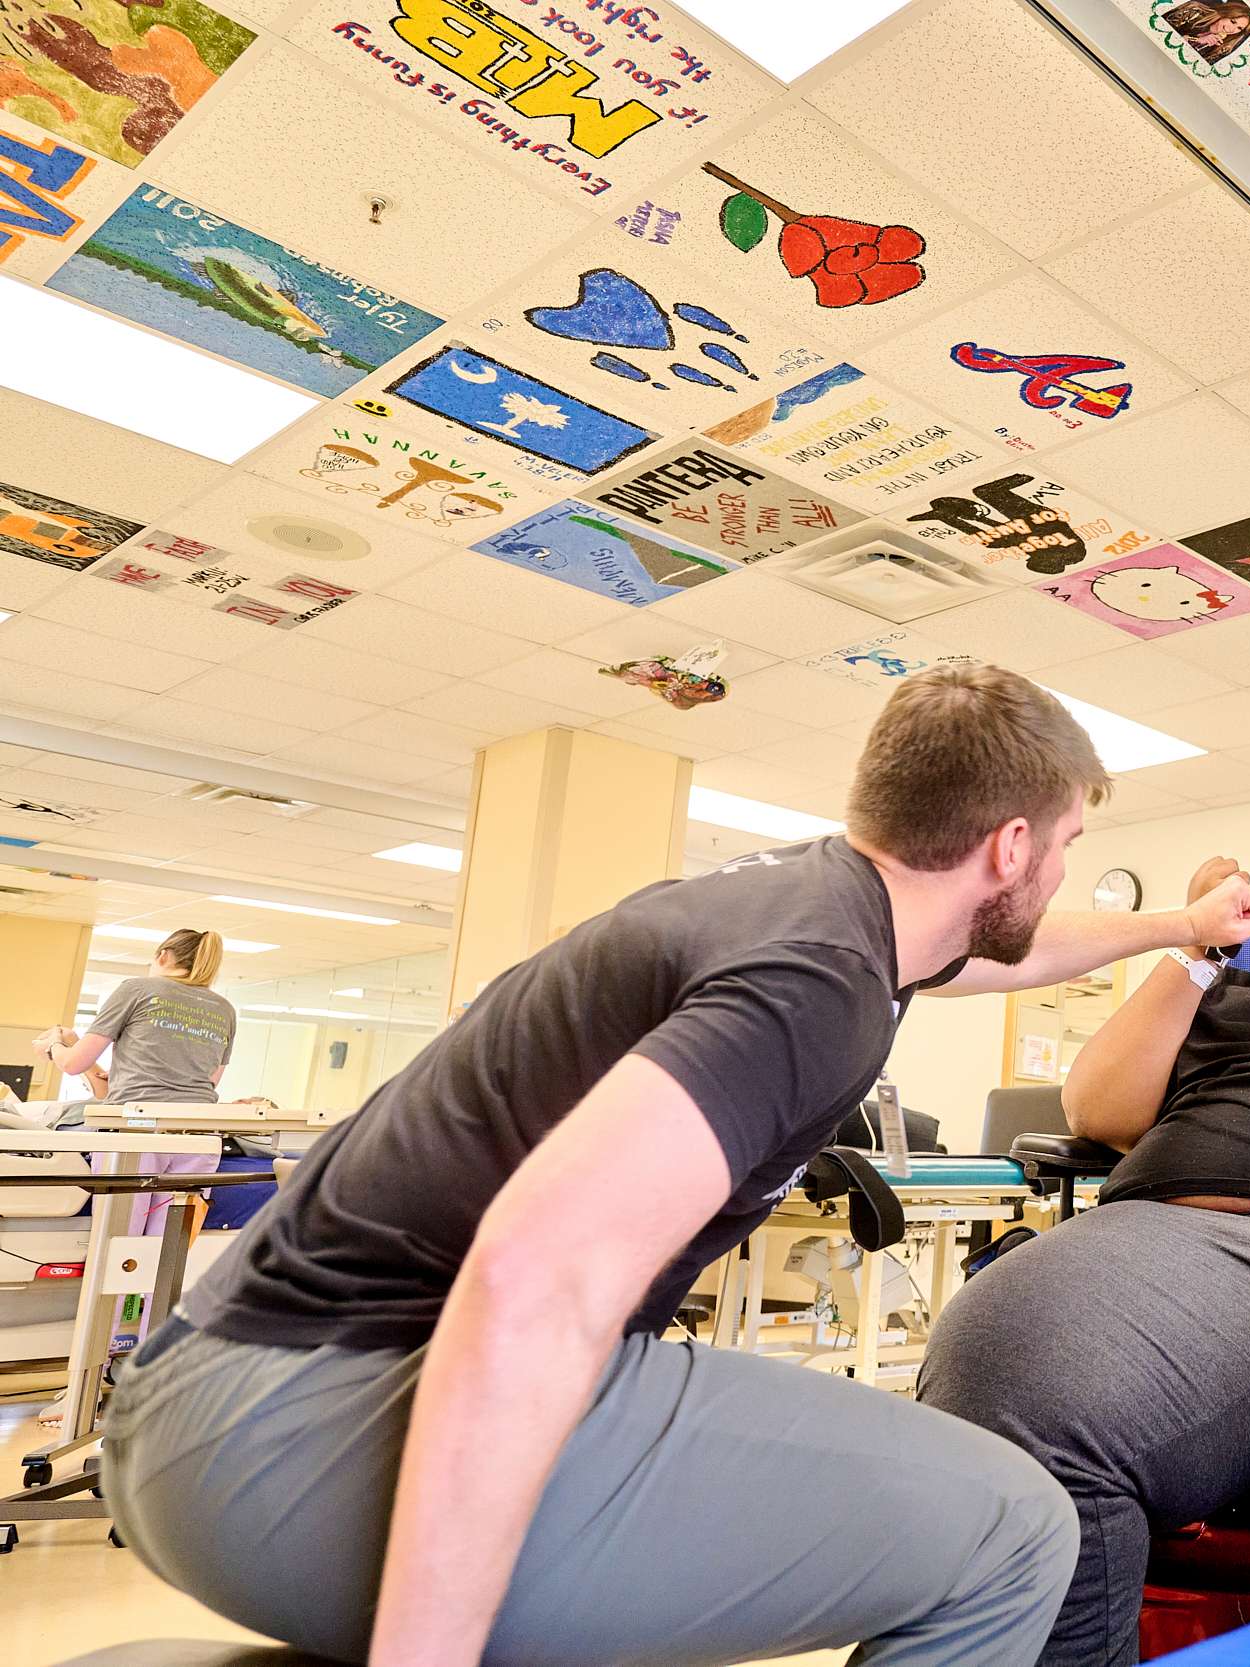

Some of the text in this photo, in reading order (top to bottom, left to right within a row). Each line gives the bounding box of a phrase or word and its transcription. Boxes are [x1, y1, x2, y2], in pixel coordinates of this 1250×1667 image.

[540, 7, 709, 130] if you look
[670, 45, 712, 84] the
[331, 21, 612, 197] Everything is funny
[141, 188, 228, 232] 2011
[338, 293, 411, 335] Tyler
[928, 450, 983, 477] TRUST
[597, 450, 766, 524] PANTERA
[670, 501, 712, 524] BE
[717, 492, 749, 548] STRONGER
[756, 506, 781, 535] THAN
